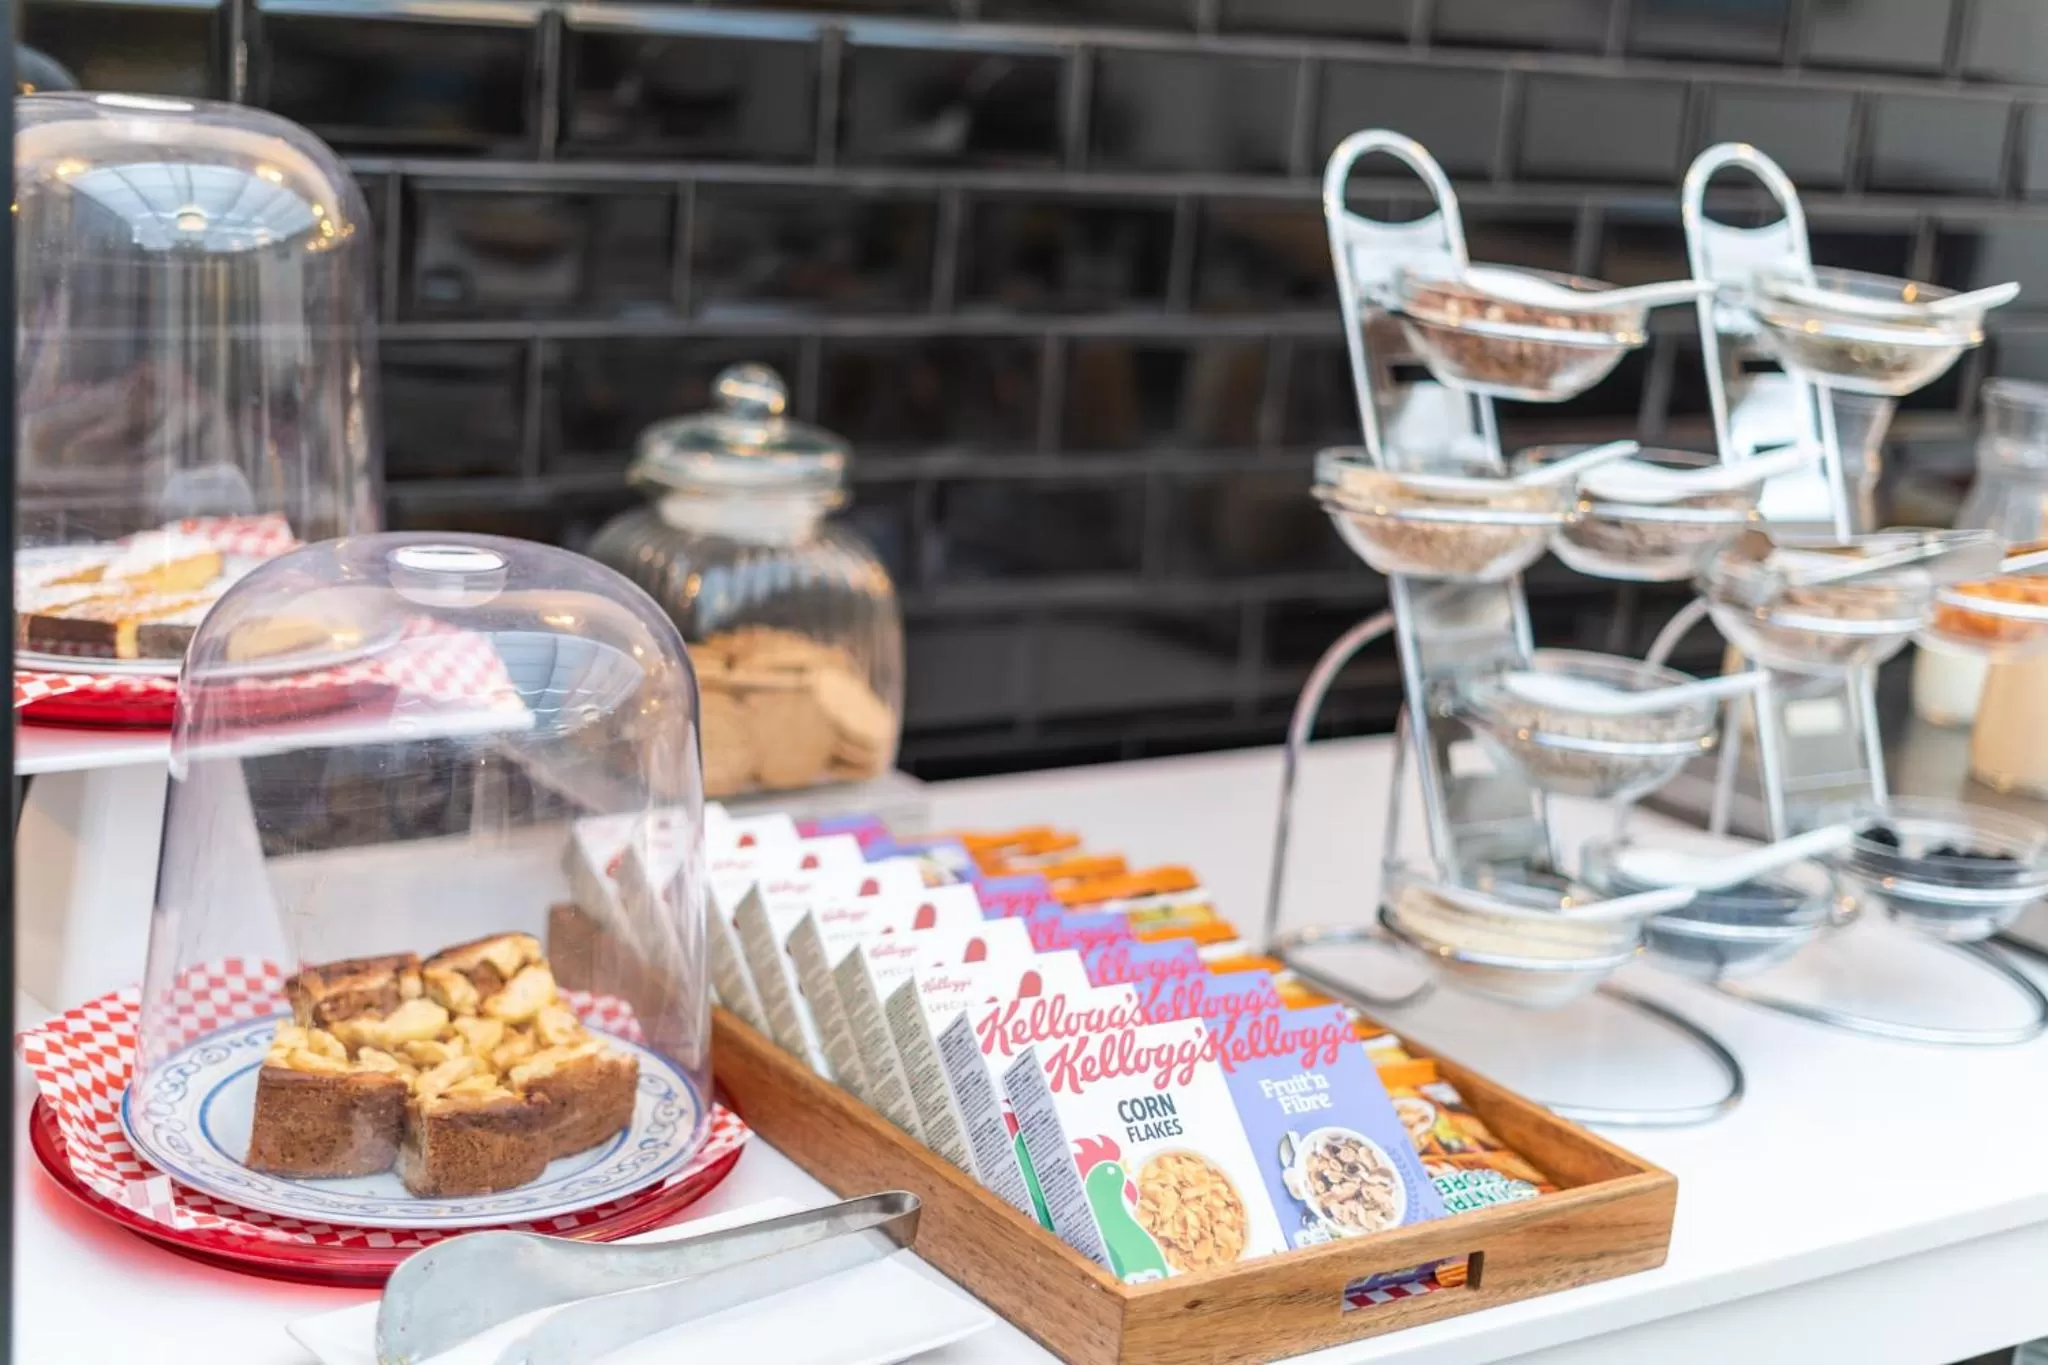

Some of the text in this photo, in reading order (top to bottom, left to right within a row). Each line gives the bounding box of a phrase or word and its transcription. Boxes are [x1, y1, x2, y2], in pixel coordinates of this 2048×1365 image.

[1044, 1026, 1219, 1094] Kellogg's
[1258, 1071, 1330, 1098] Fruit'n
[1118, 1093, 1177, 1124] CORN
[1279, 1092, 1334, 1115] Fibre
[1126, 1118, 1184, 1143] FLAKES
